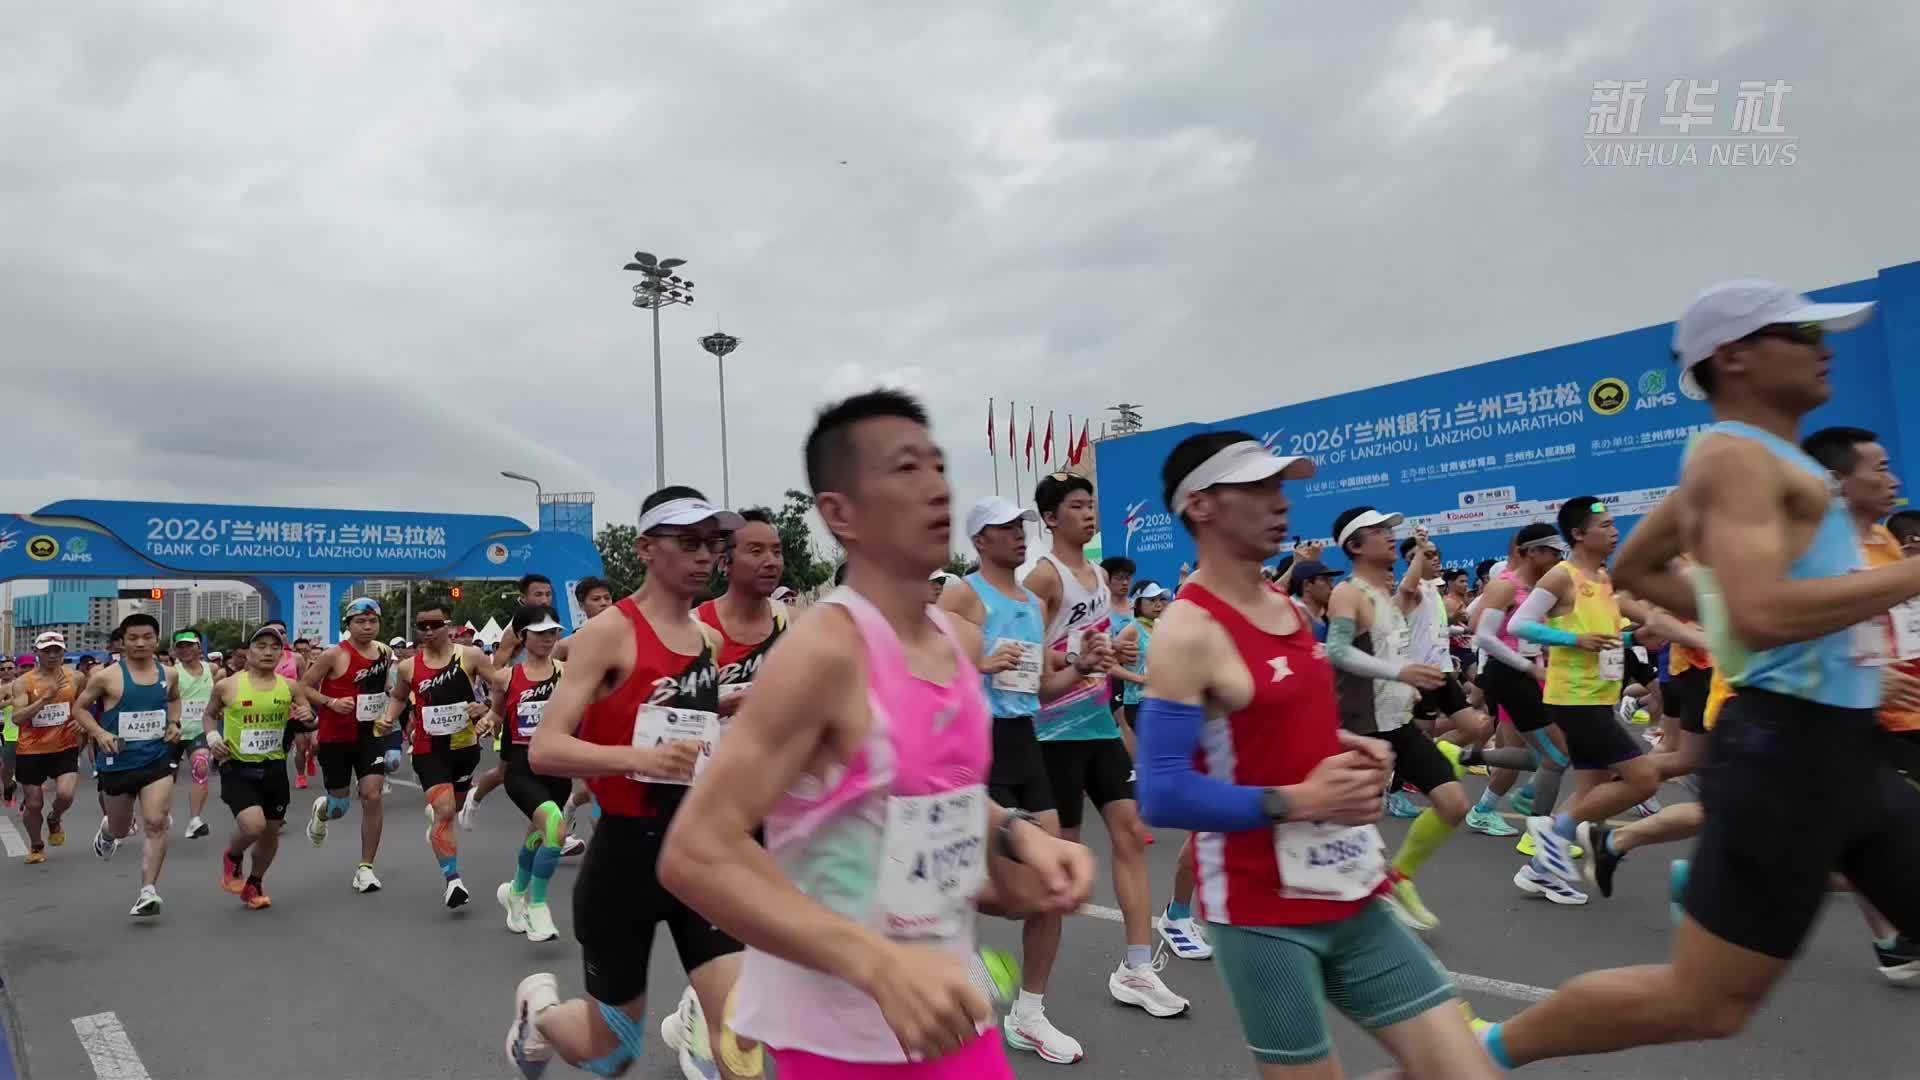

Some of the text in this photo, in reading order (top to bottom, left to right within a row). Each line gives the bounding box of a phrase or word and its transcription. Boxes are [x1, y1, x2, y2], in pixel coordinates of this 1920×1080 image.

[1635, 392, 1677, 411] AIMS
[1330, 450, 1347, 464] OF
[1425, 424, 1493, 448] LANZHOU
[1497, 409, 1584, 436] MARATHON
[1145, 513, 1172, 527] 2026
[1141, 533, 1173, 544] LANZHOU
[199, 543, 221, 556] OF
[308, 545, 373, 558] LANZHOU
[376, 546, 446, 560] MARATHON
[1136, 542, 1174, 553] MARATHON
[61, 552, 93, 562] AIMS
[451, 587, 460, 597] 13
[430, 714, 463, 725] A25477
